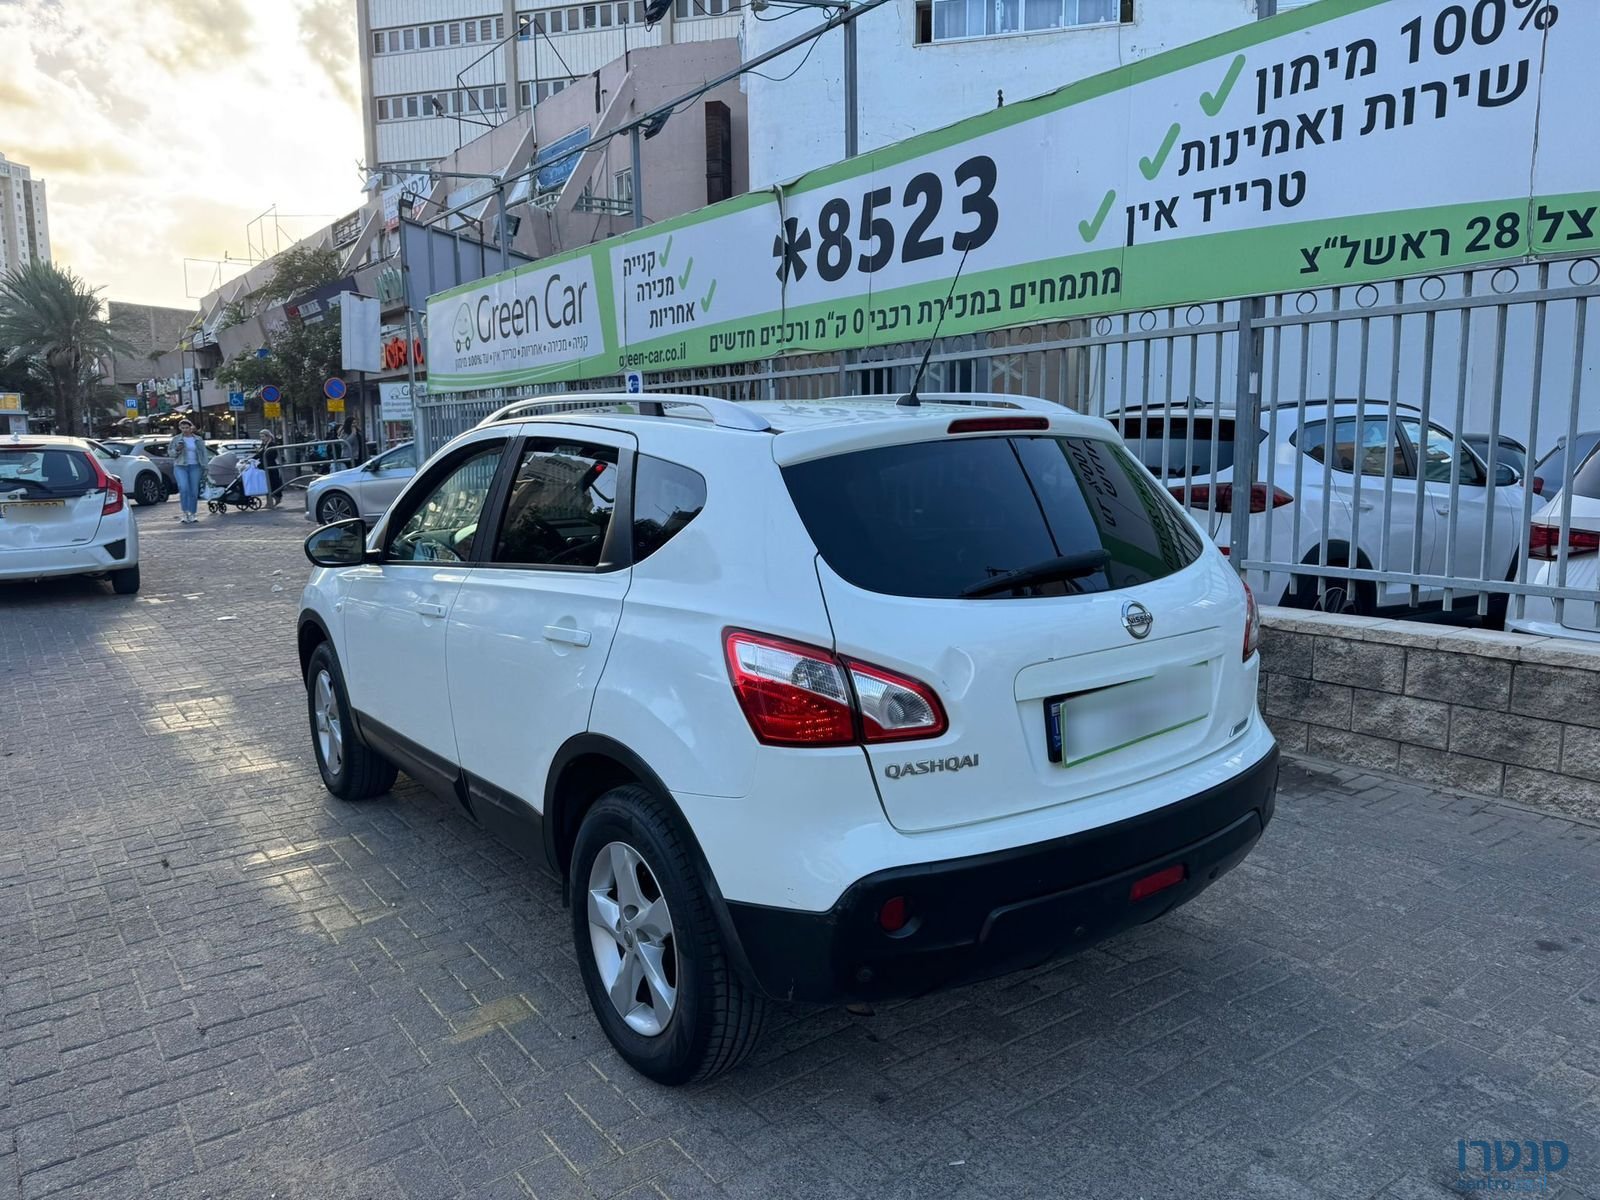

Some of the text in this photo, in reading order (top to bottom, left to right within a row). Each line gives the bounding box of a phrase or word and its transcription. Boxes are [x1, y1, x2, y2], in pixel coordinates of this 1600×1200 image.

[1256, 0, 1559, 115] מימון 100%
[1178, 58, 1530, 177] שירות ואמינות
[1125, 170, 1306, 248] טרייד אין
[1300, 228, 1450, 274] ראשל"צ
[1465, 211, 1521, 253] 28
[623, 251, 656, 277] קנייה
[476, 273, 588, 344] Green Car
[637, 276, 674, 302] מכירה
[710, 266, 1121, 353] מתמחים במכירת רכבי 0 ק"מ ורכבים חדשים
[649, 301, 695, 329] אחריות
[547, 339, 567, 353] מכירה
[885, 753, 979, 779] QASHQAI
